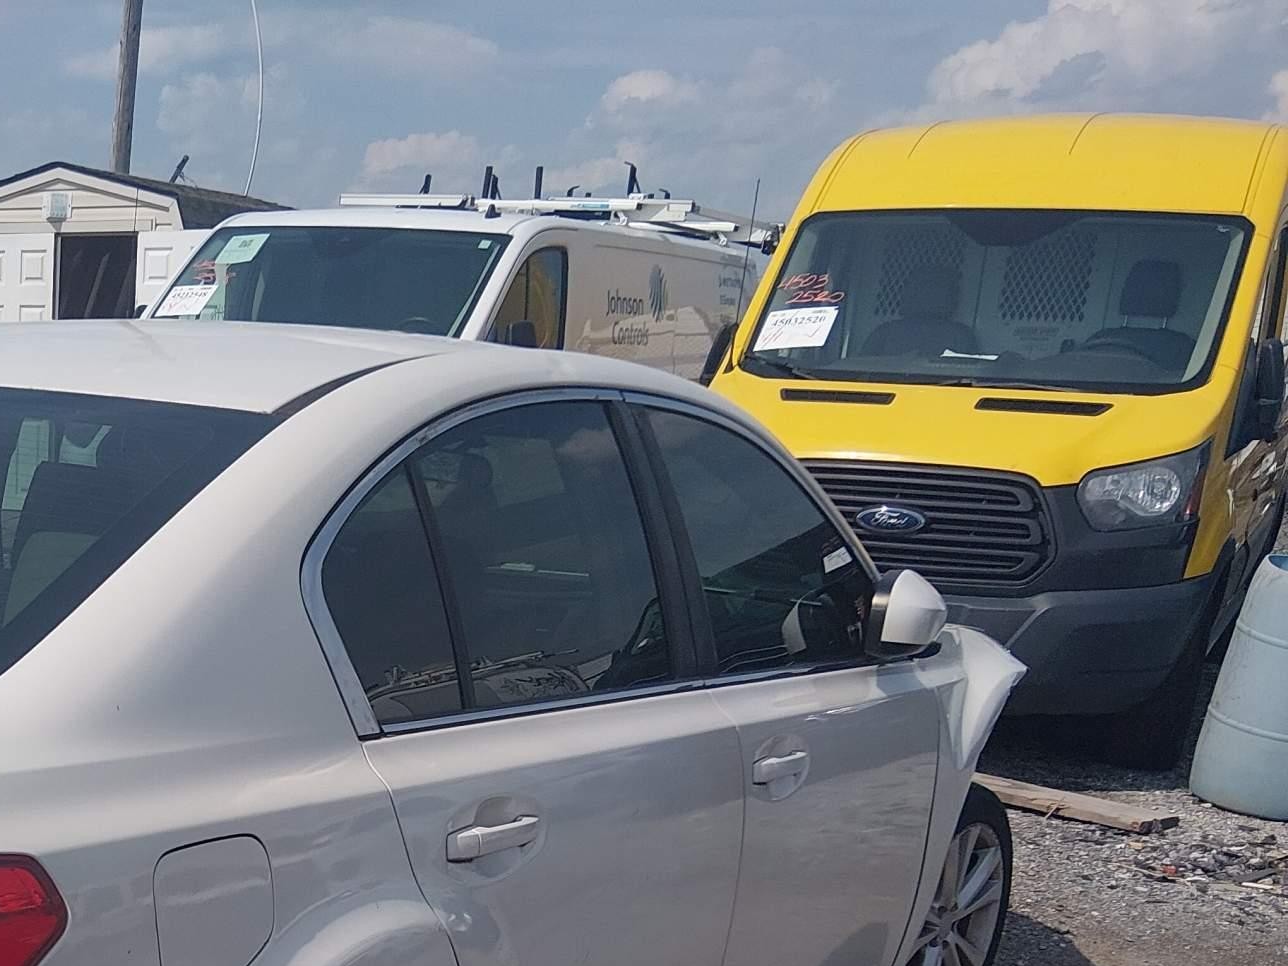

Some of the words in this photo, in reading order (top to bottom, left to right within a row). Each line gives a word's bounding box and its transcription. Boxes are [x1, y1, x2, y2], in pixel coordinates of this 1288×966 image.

[777, 272, 829, 290] 4503
[606, 289, 644, 316] Johnson
[612, 320, 649, 346] Controls
